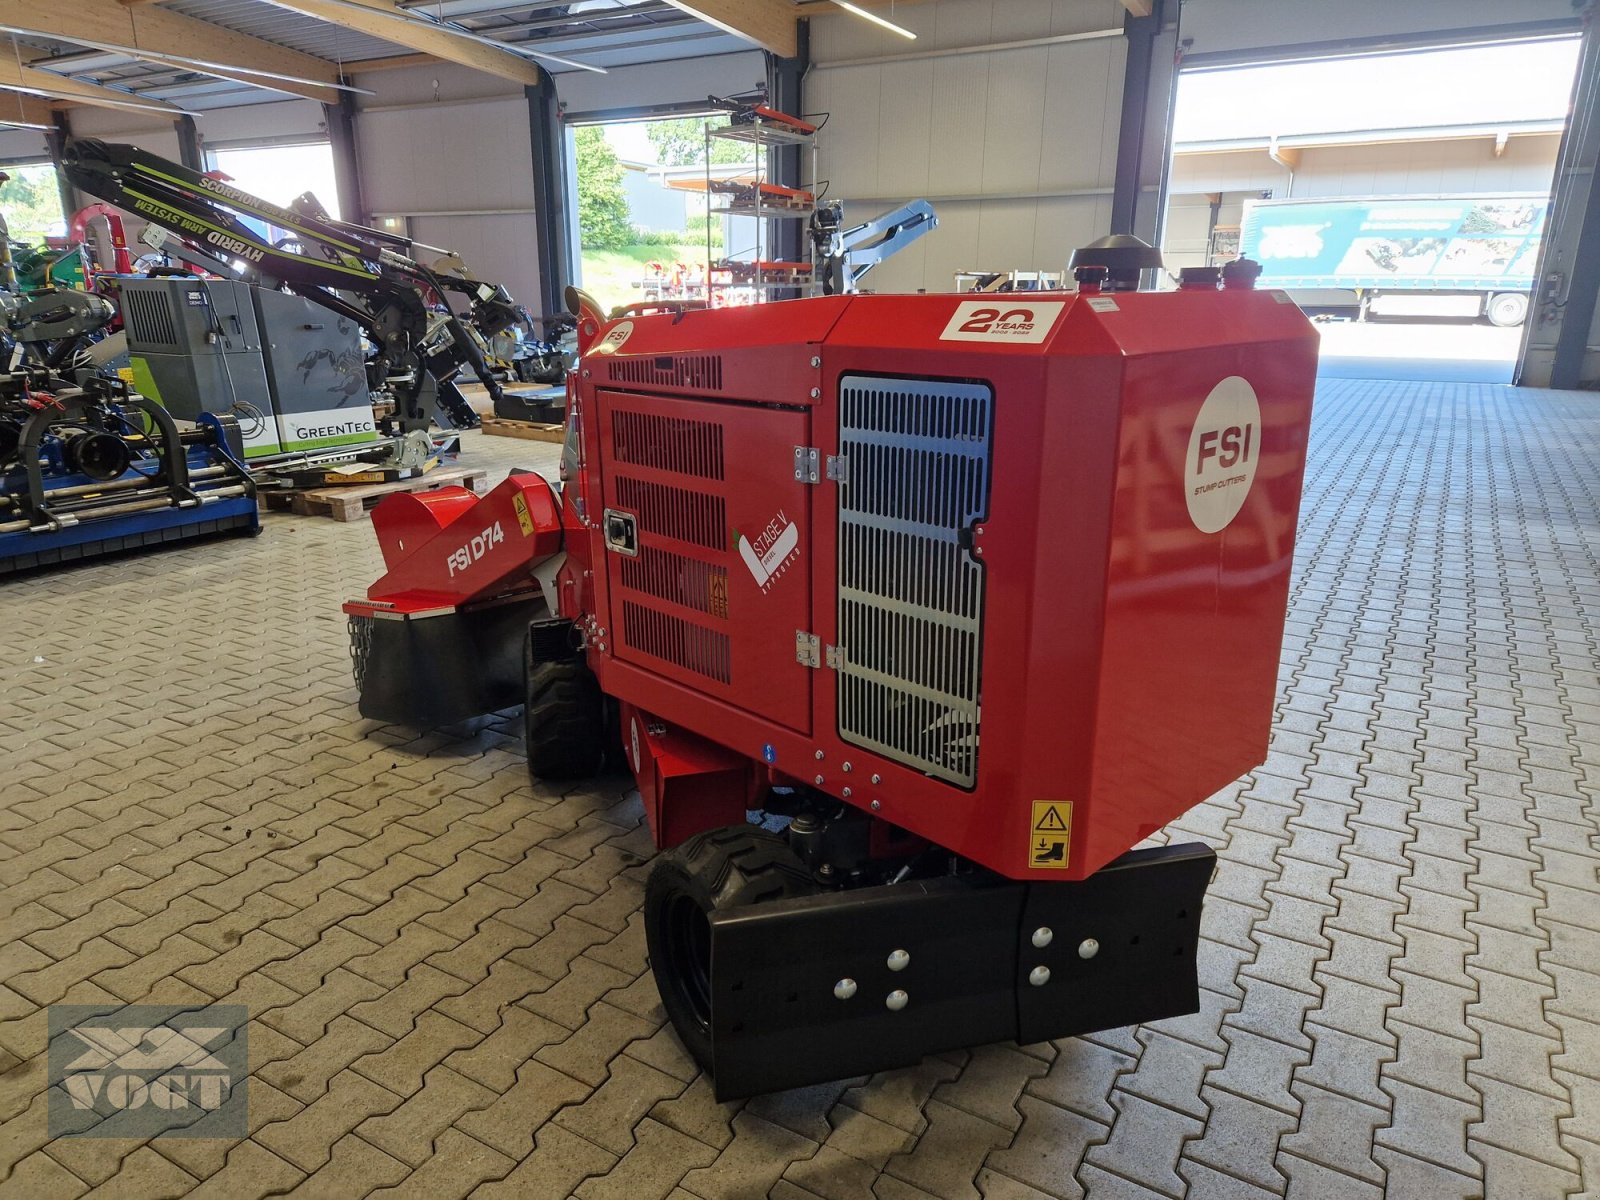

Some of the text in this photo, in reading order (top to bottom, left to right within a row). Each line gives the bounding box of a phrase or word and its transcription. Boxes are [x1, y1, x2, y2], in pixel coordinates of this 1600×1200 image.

[199, 177, 260, 208] SCORPION
[134, 200, 181, 224] SYSTEM
[181, 219, 206, 235] ARM
[207, 231, 265, 263] HYBRID
[607, 331, 629, 341] FSI
[996, 322, 1035, 330] YEARS
[1197, 423, 1252, 475] FSI
[1194, 474, 1247, 496] STUMP CUTTERS
[753, 508, 788, 558] STAGE V
[447, 520, 505, 578] FSI D74
[761, 547, 801, 595] APPROVED
